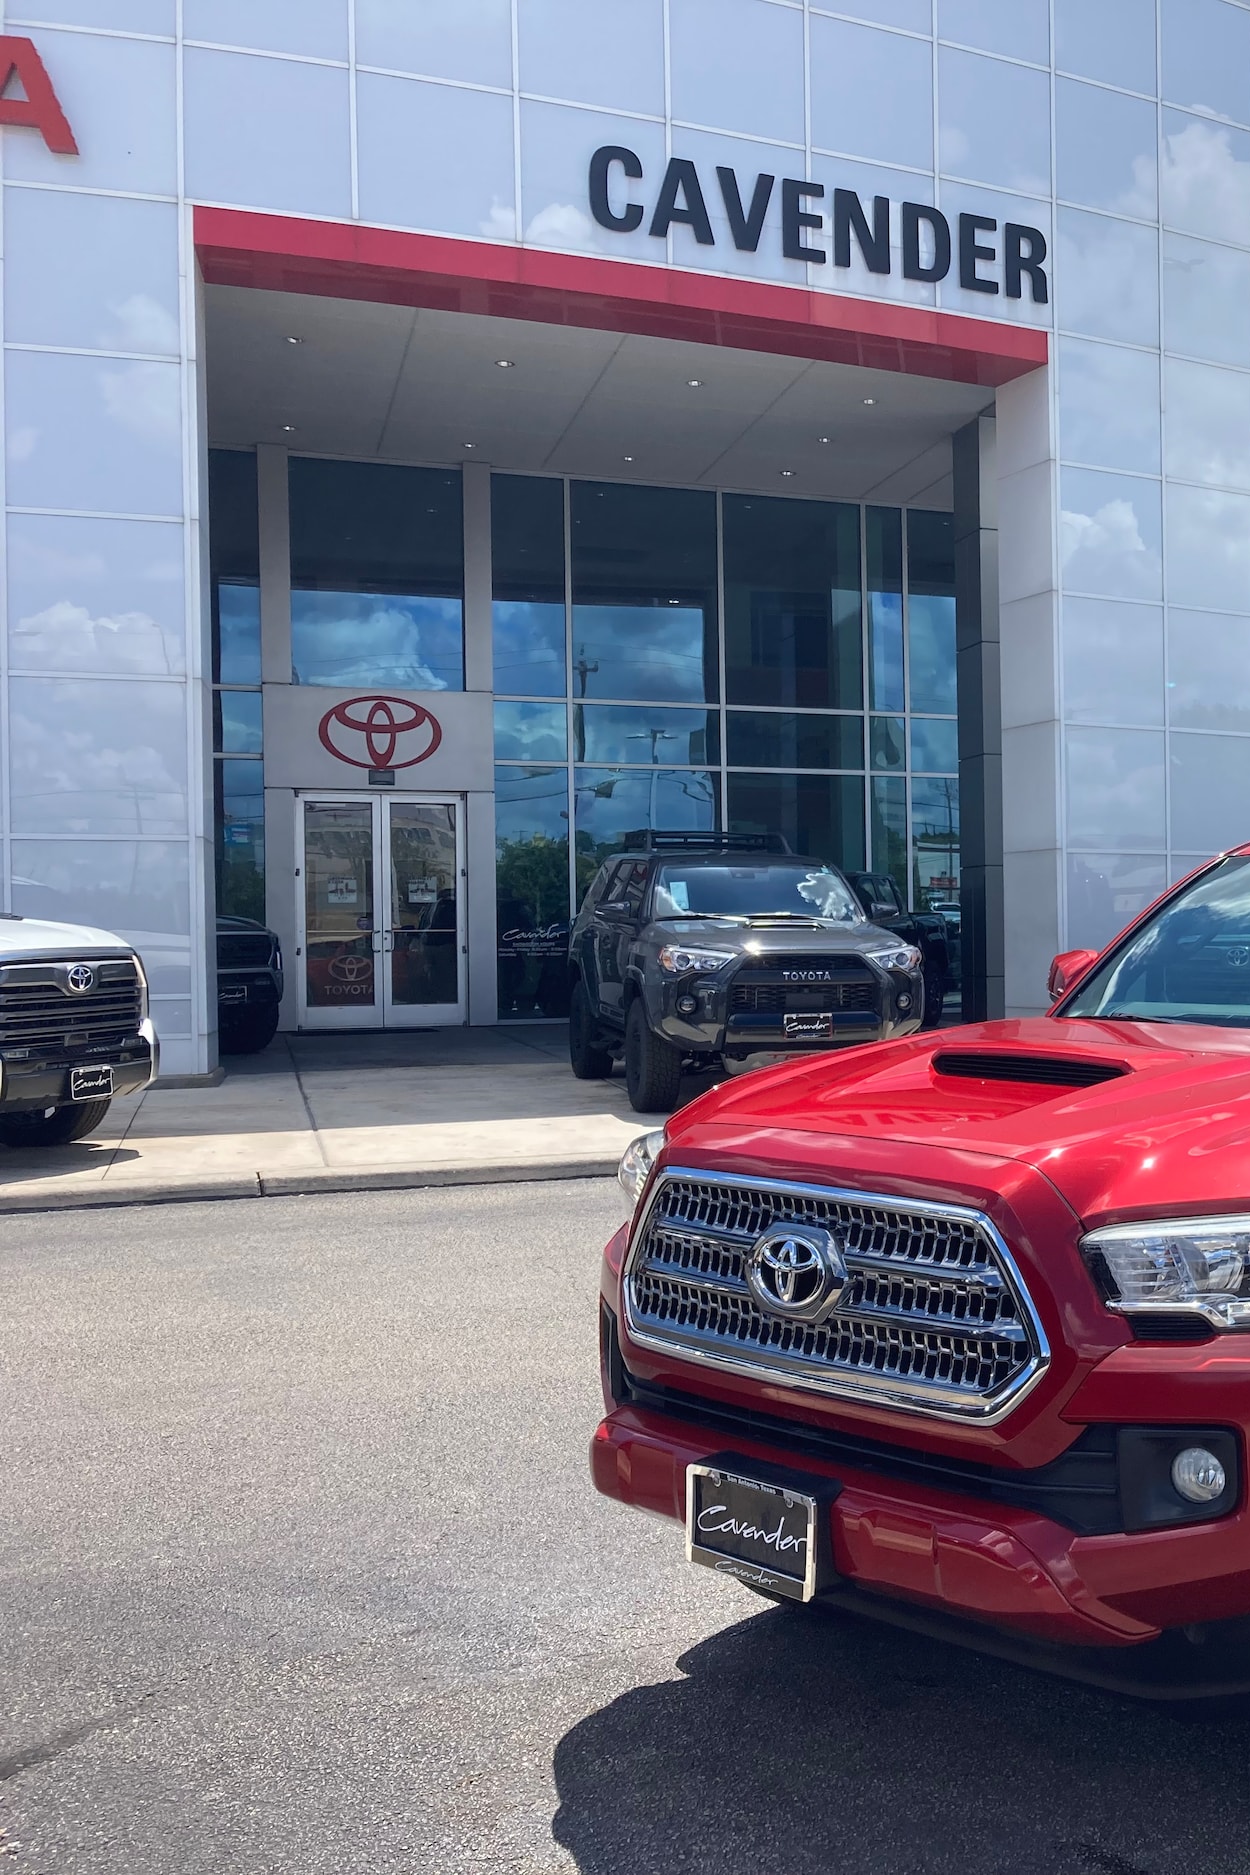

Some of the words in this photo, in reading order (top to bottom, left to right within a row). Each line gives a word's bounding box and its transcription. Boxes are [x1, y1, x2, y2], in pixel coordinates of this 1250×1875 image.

[588, 145, 1049, 304] CAVENDER
[782, 971, 831, 981] TOYOTA
[697, 1505, 807, 1552] Cavender
[714, 1561, 779, 1586] Cavender
